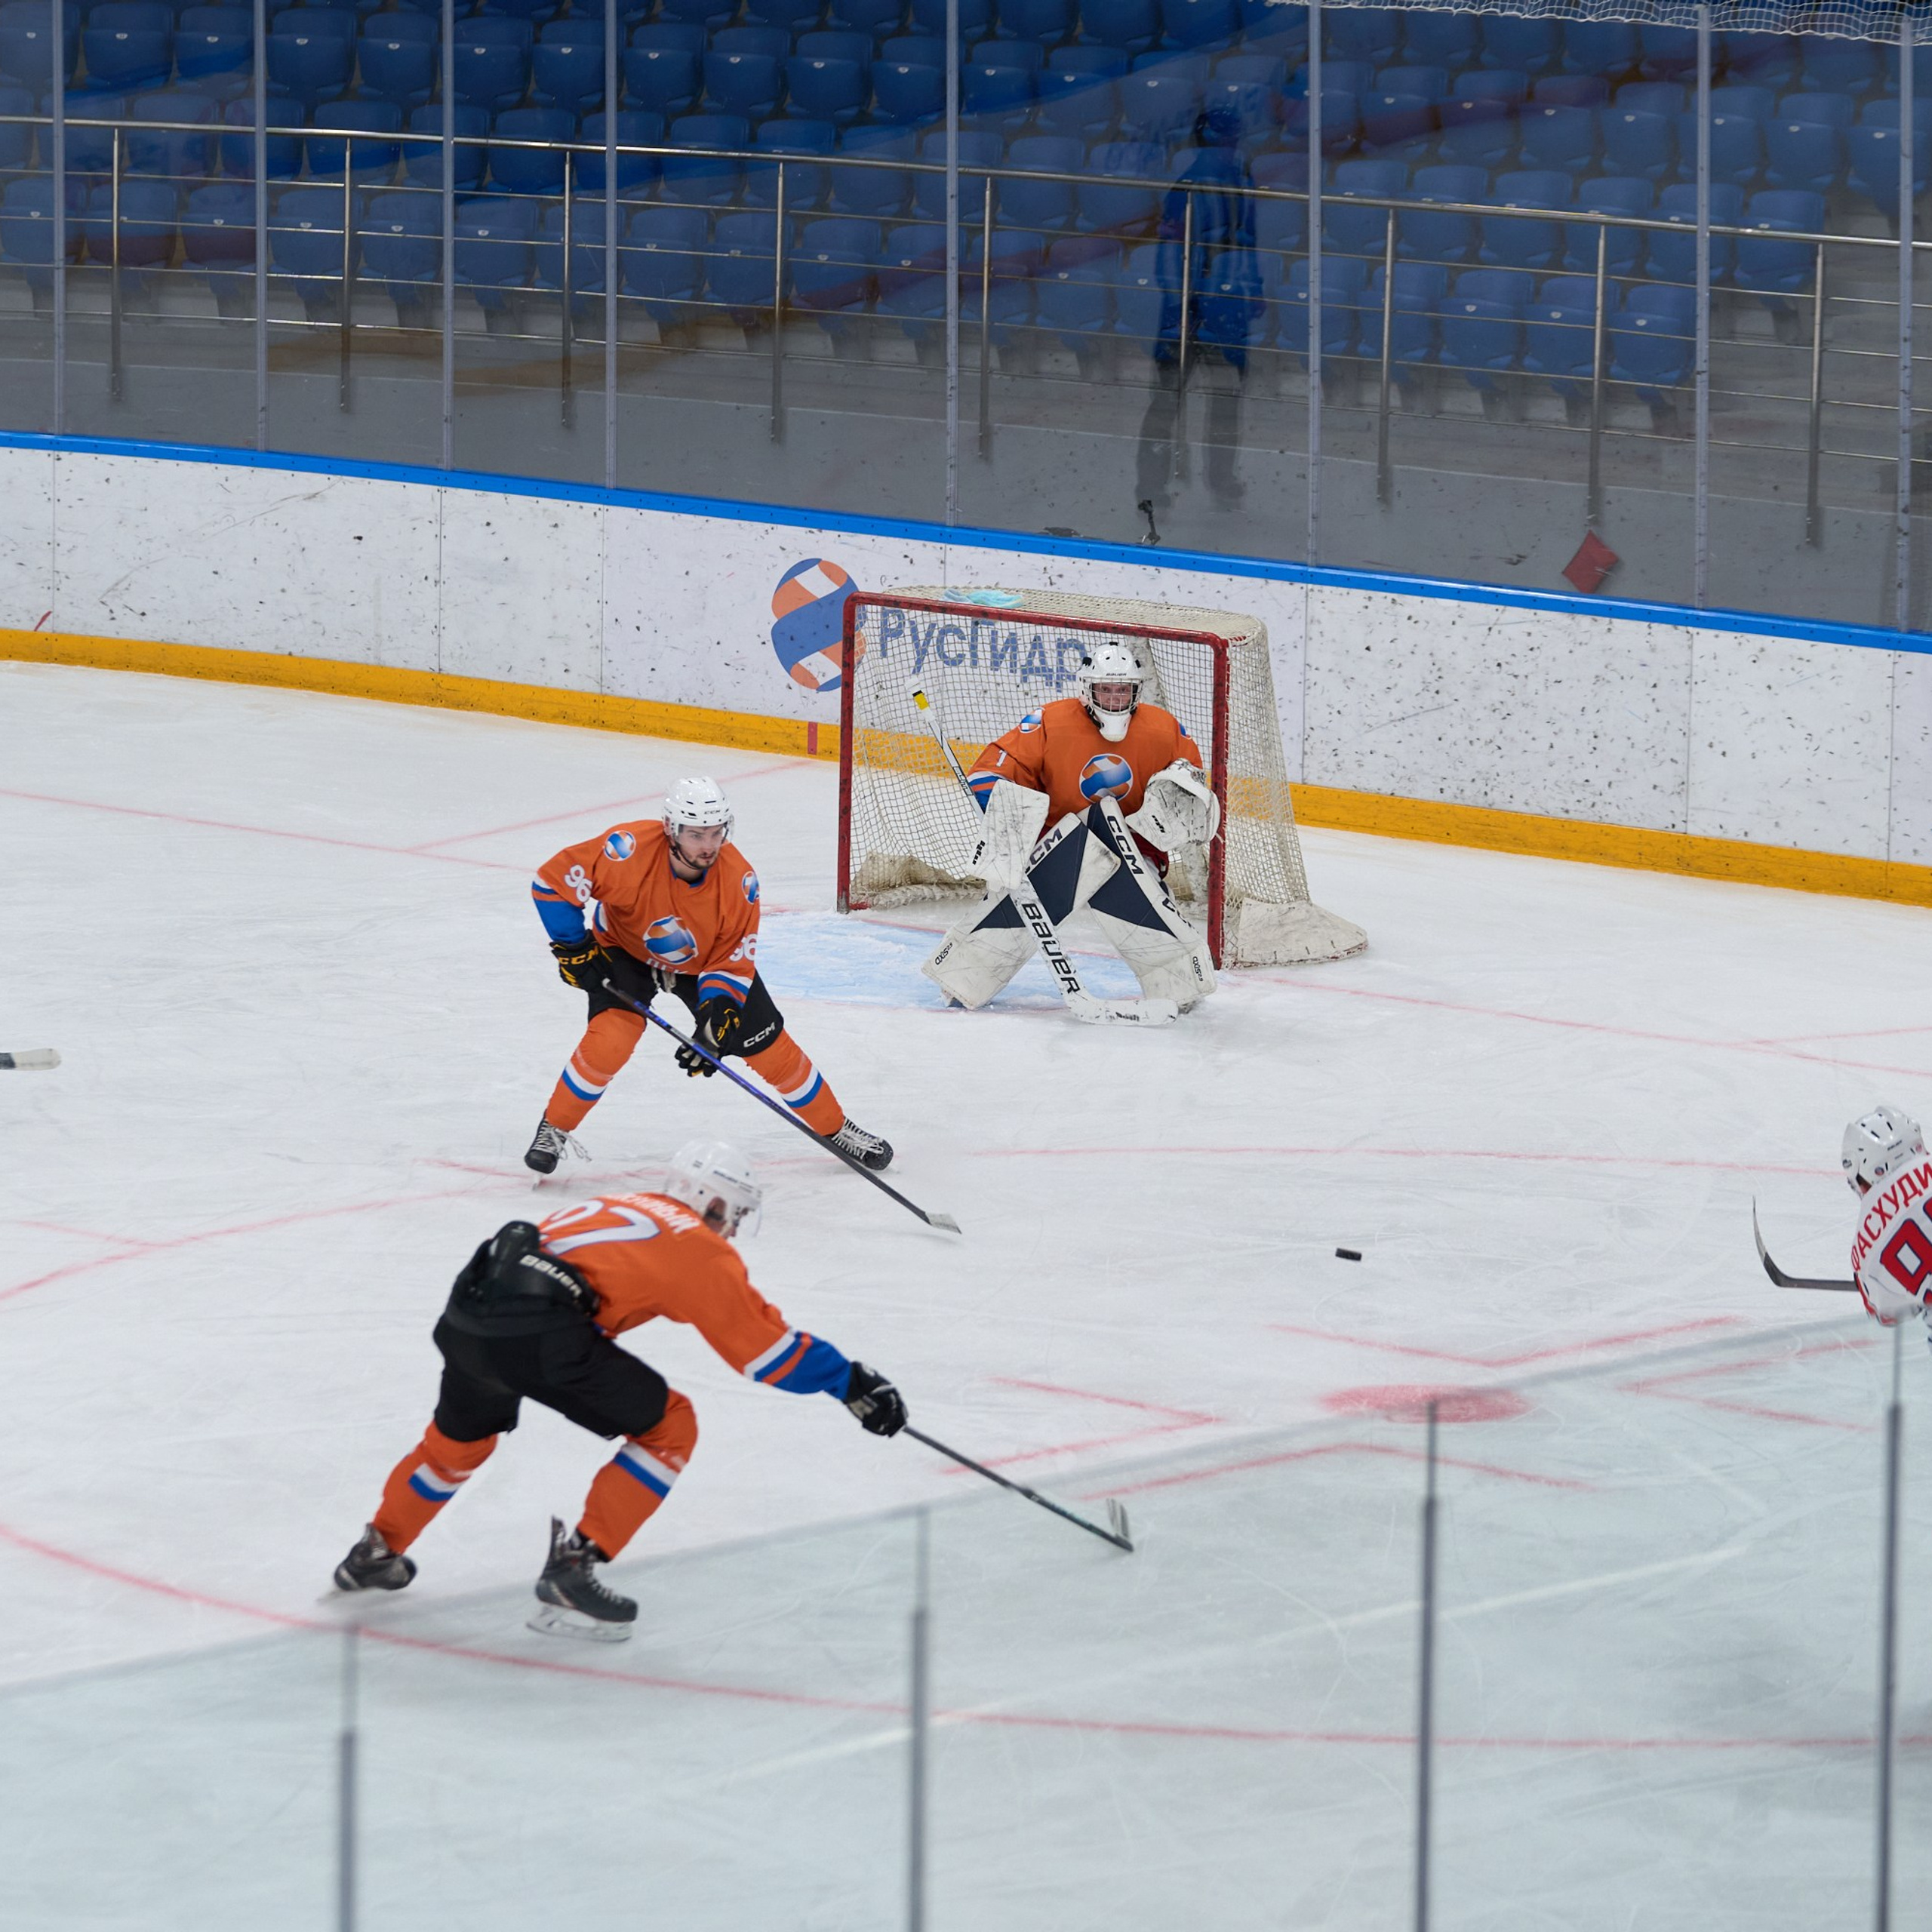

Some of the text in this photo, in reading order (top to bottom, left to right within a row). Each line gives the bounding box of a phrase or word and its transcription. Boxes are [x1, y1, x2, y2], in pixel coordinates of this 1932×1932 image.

[995, 749, 1008, 768] 1
[1025, 828, 1063, 874] CM
[1107, 816, 1144, 874] CCM
[564, 864, 593, 903] 96
[558, 945, 598, 964] CCM
[743, 1022, 776, 1048] CCM
